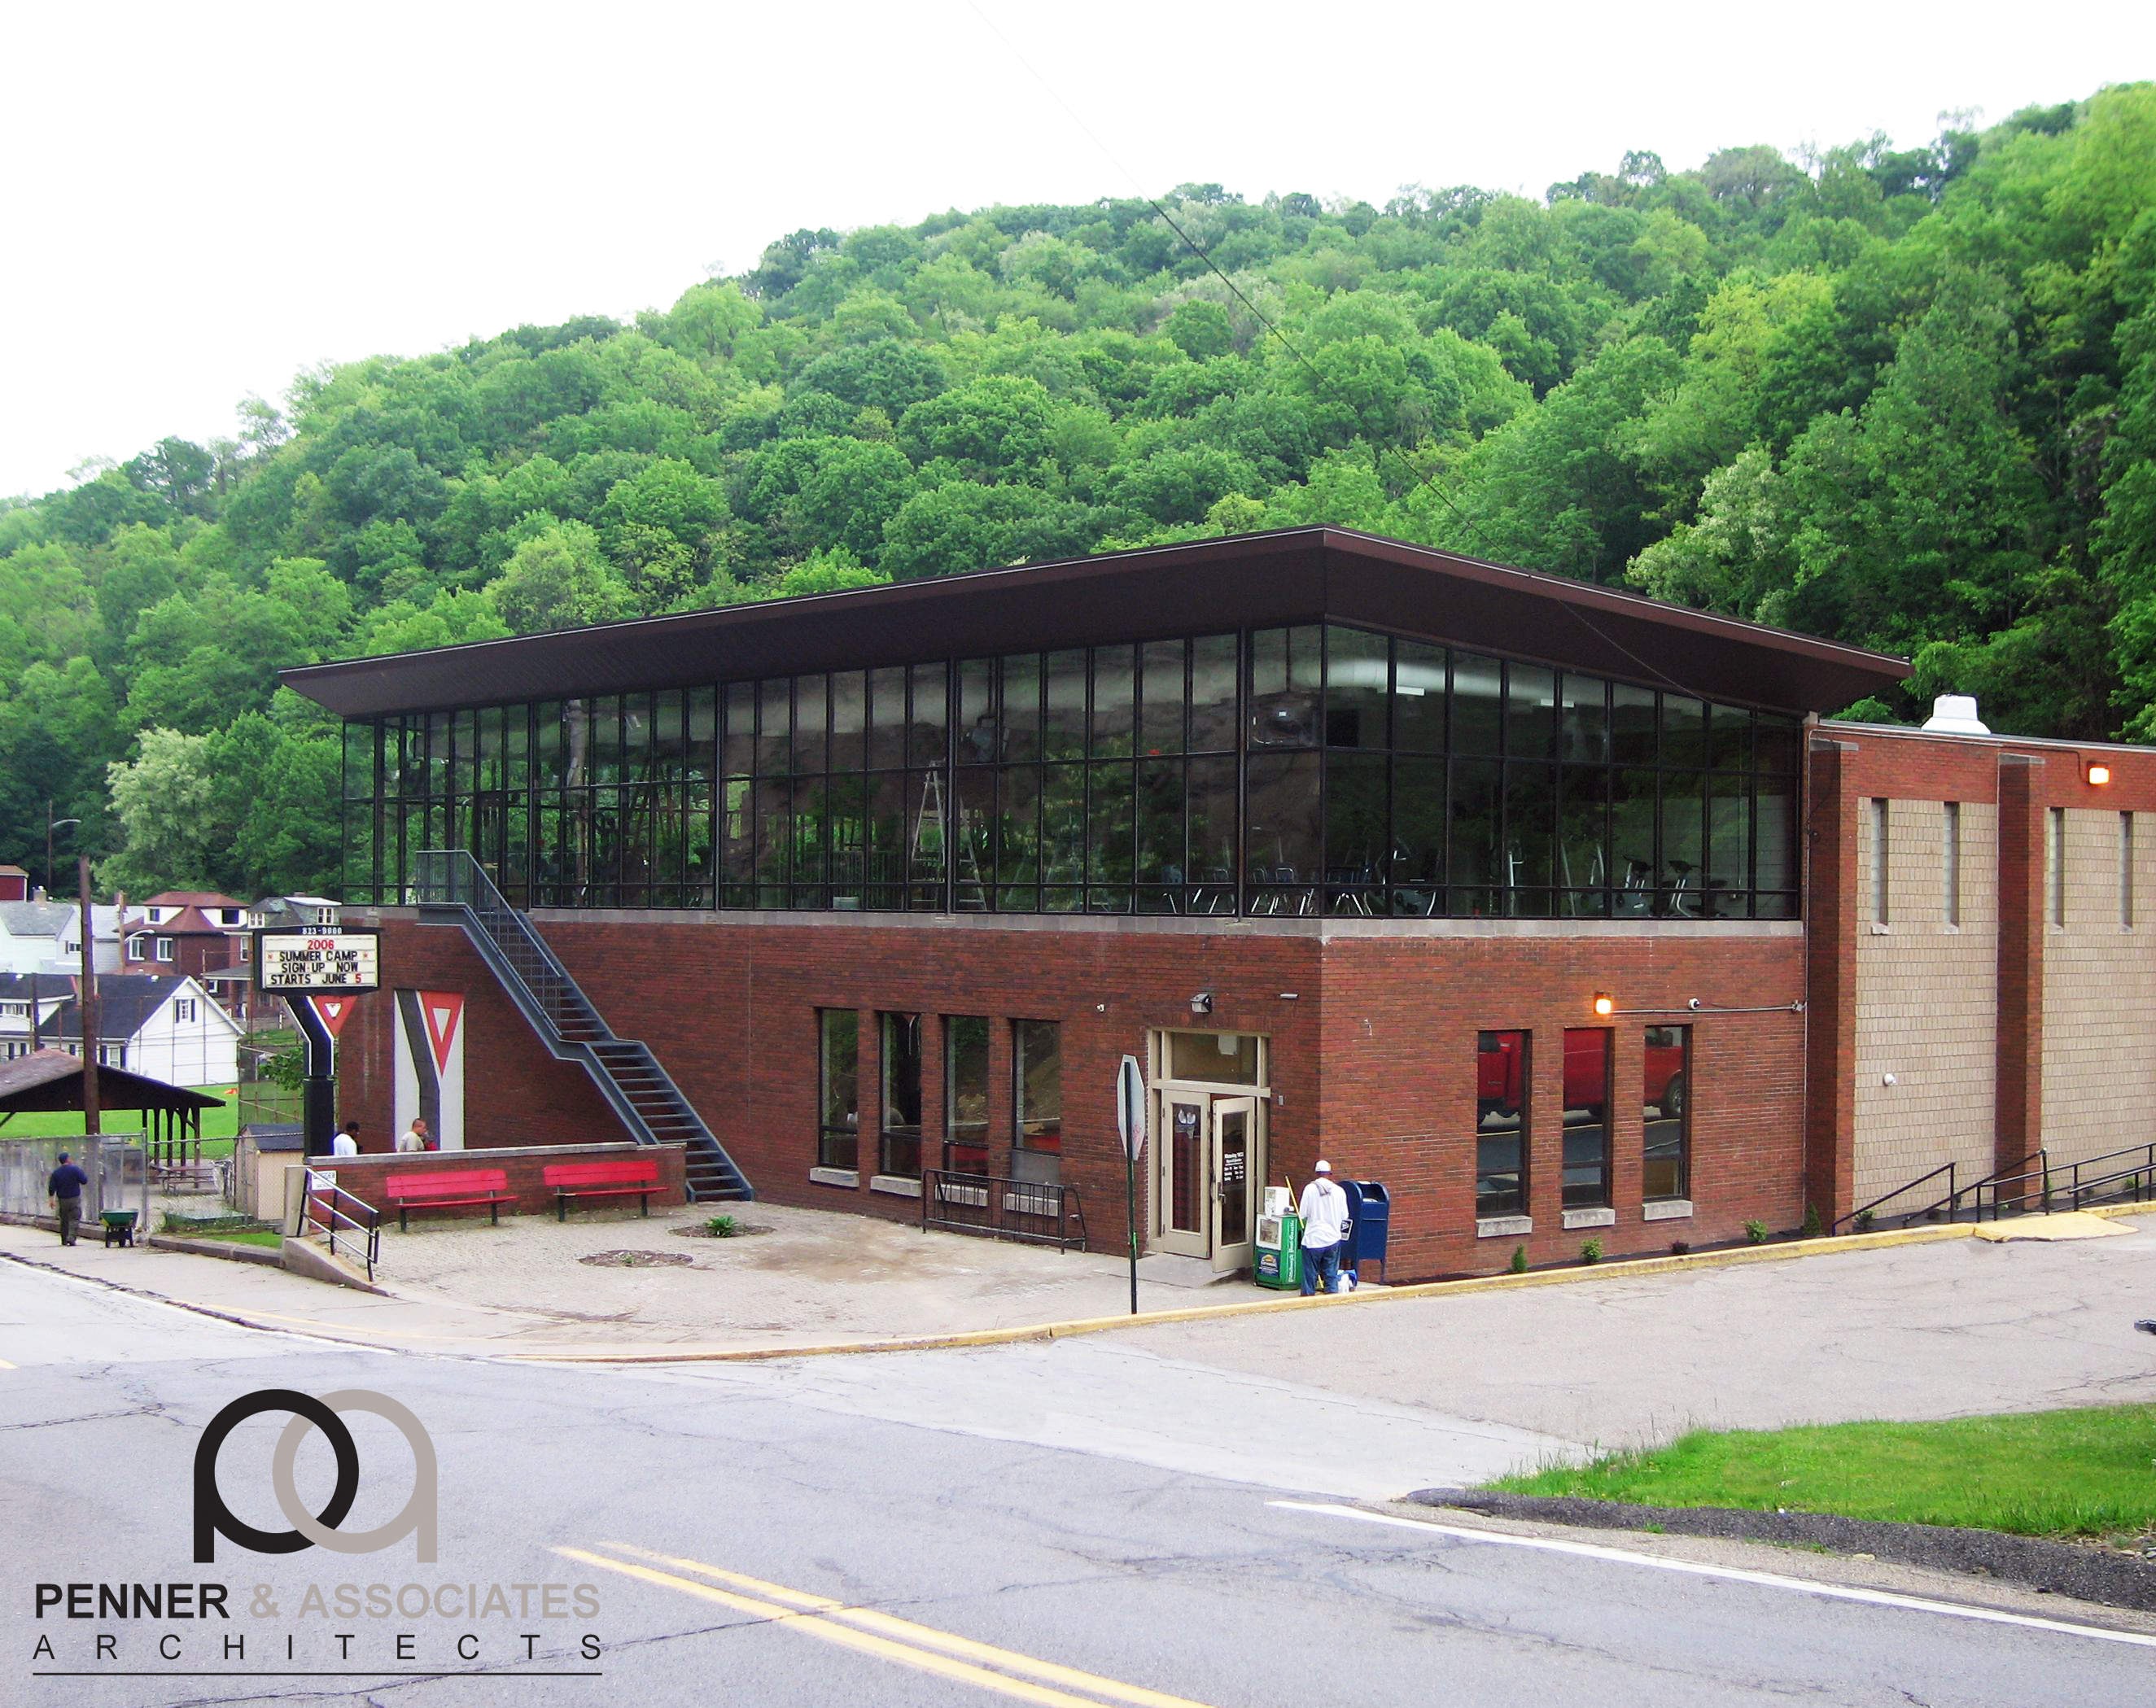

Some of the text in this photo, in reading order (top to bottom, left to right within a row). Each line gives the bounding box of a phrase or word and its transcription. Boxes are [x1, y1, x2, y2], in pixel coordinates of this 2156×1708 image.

[307, 939, 335, 950] 2006
[279, 950, 358, 962] SUMMER CAMP
[336, 962, 358, 972] NOW
[271, 973, 361, 985] STARTS JUNE 5
